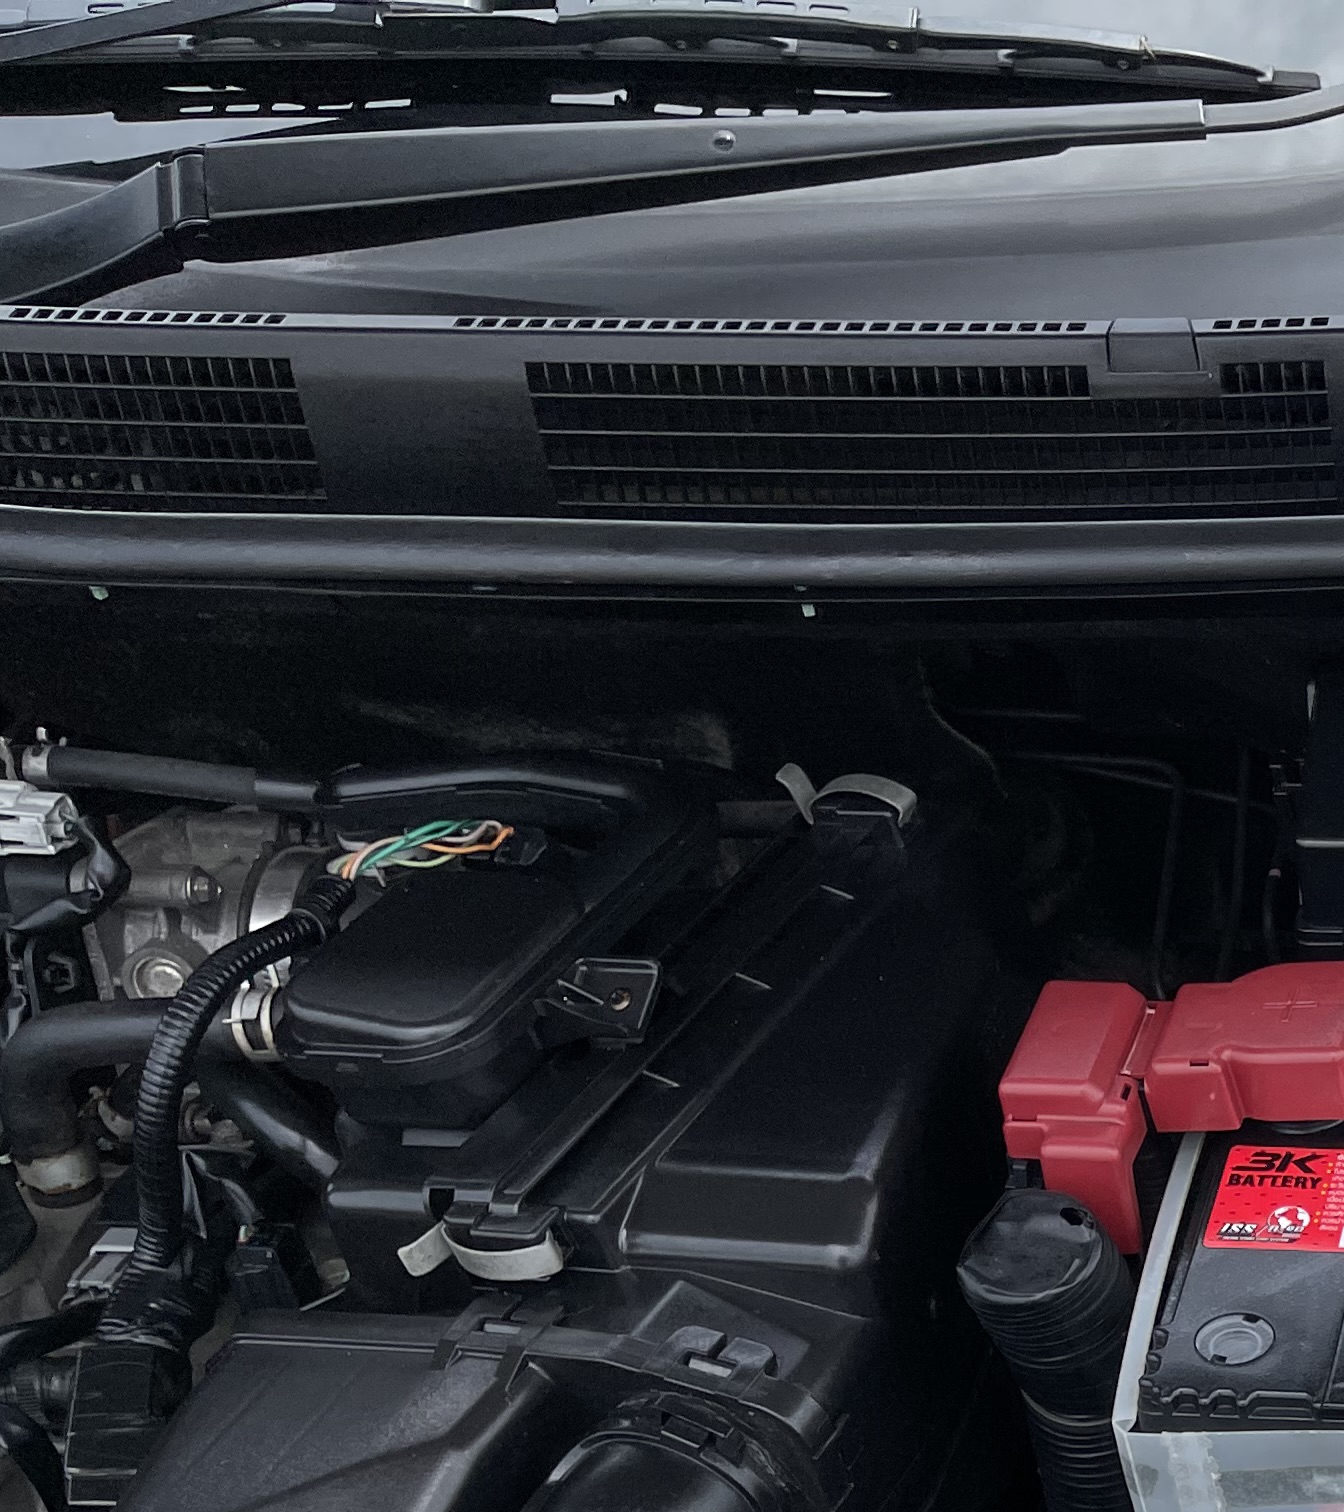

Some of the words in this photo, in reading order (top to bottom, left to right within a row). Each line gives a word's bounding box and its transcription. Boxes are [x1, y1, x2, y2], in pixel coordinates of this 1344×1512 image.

[1232, 1151, 1328, 1174] 3K
[1227, 1173, 1323, 1189] BATTERY
[1217, 1223, 1258, 1235] ISS
